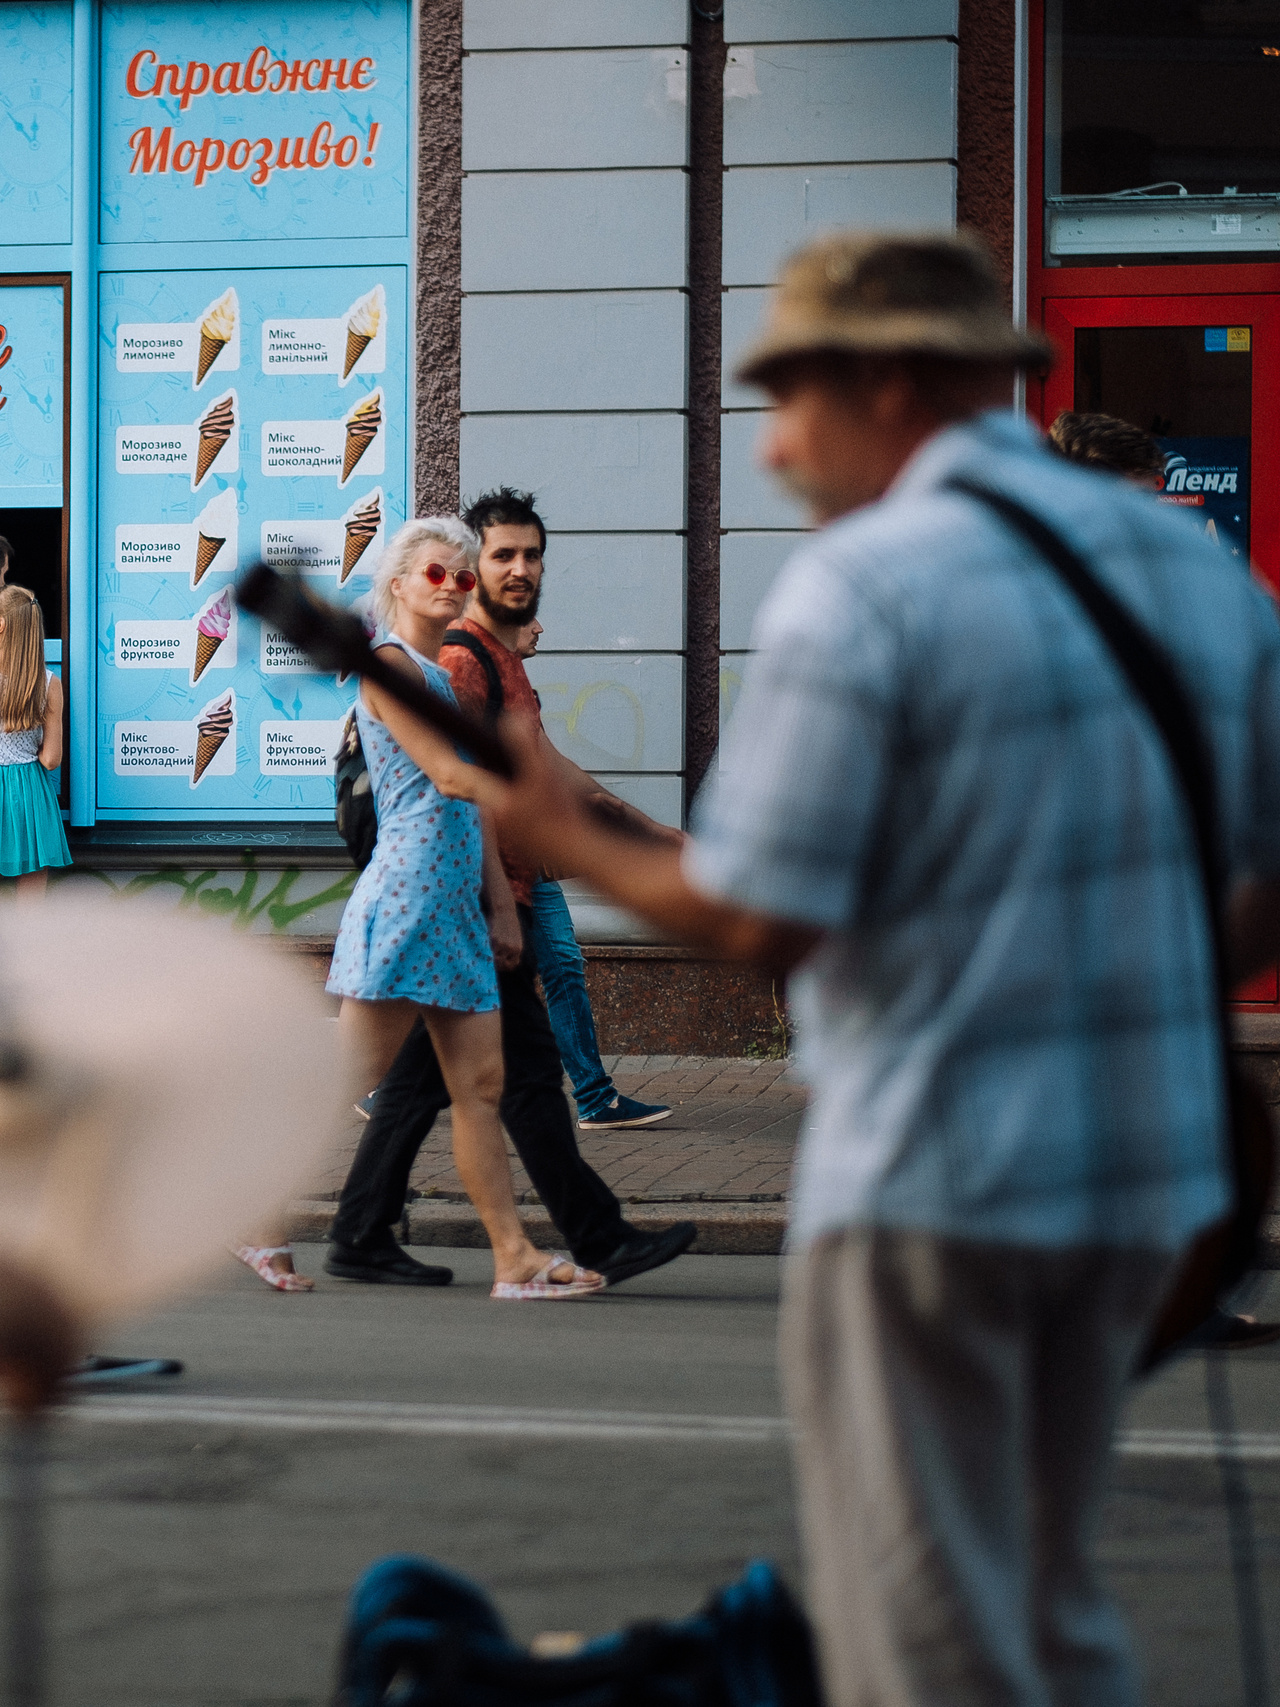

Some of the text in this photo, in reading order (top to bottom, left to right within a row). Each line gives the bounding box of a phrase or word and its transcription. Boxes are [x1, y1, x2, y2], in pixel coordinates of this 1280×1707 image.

[125, 46, 376, 111] Справжнє
[128, 121, 381, 187] Морозиво!
[268, 329, 296, 339] Мікс
[123, 338, 183, 350] Морозиво
[268, 342, 326, 351] лимонно-
[122, 351, 176, 360] лимонне
[268, 352, 328, 363] ванільний
[268, 433, 295, 443] Мікс
[121, 440, 182, 451] Морозиво
[267, 445, 326, 454] лимонно-
[121, 452, 188, 463] шоколадне
[268, 455, 342, 467] шоколадний
[266, 533, 294, 543] Мікс
[121, 541, 181, 553] Морозиво
[266, 545, 323, 555] ванільно-
[121, 552, 172, 563] ванільне
[267, 556, 341, 568] шоколадний
[120, 638, 180, 650] Морозиво
[120, 650, 175, 661] фруктове
[120, 732, 147, 743] Мікс
[266, 732, 293, 743] Мікс
[120, 744, 179, 757] фруктово-
[266, 744, 326, 757] фруктово-
[120, 755, 194, 768] шоколадний
[266, 756, 327, 766] лимонний
